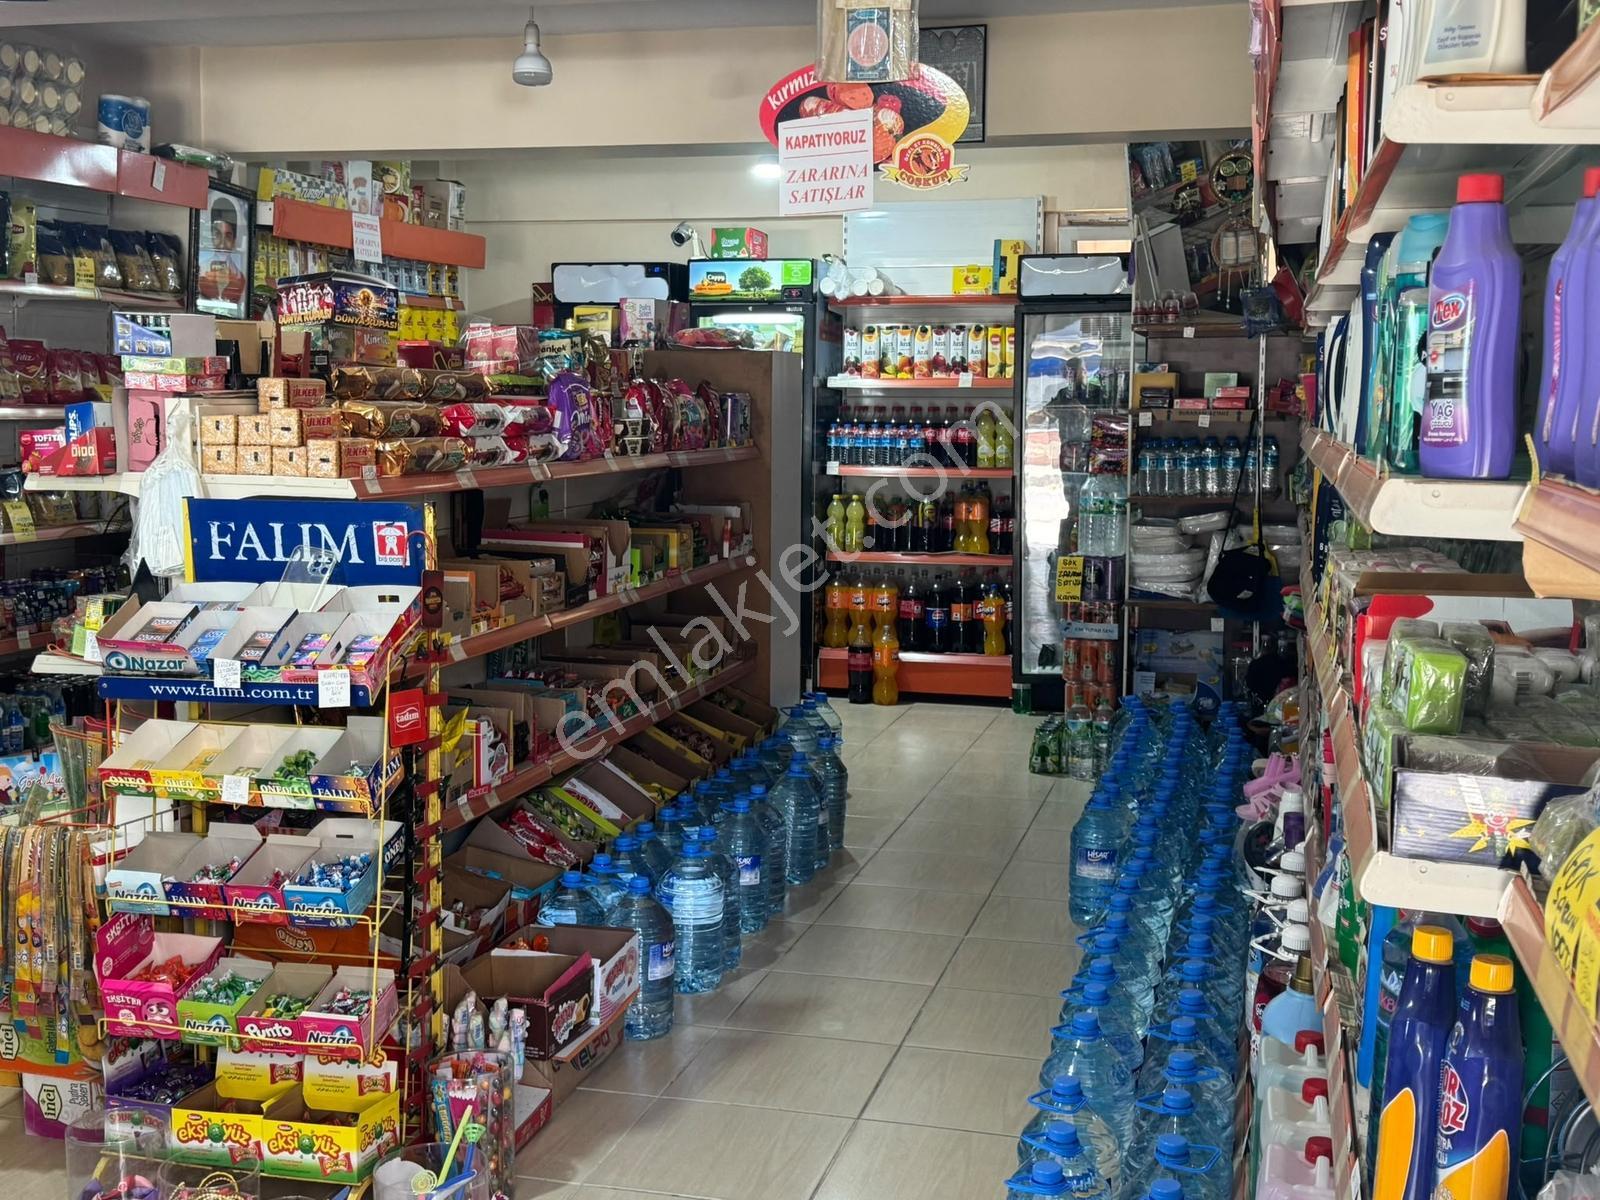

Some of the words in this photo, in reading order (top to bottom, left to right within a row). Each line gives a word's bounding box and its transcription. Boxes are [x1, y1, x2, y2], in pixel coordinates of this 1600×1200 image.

[785, 129, 866, 150] KAPATIYORUZ
[786, 164, 868, 184] ZARARINA
[789, 185, 865, 204] SATIŞLAR
[1434, 299, 1461, 322] Tex
[335, 315, 364, 327] DÜNYA
[1431, 400, 1453, 417] YAĞ
[208, 520, 364, 564] FALIM
[130, 656, 187, 671] Nazar
[395, 709, 419, 724] tadım
[46, 771, 64, 786] Luc
[317, 787, 356, 799] FALIM
[172, 895, 207, 905] FALIM
[245, 1022, 293, 1039] Punto
[2, 1027, 14, 1058] inci
[44, 1088, 56, 1118] inci
[177, 1119, 209, 1143] ekşi
[223, 1123, 252, 1146] yüz
[268, 1130, 299, 1155] ekşi
[313, 1134, 342, 1158] yüz
